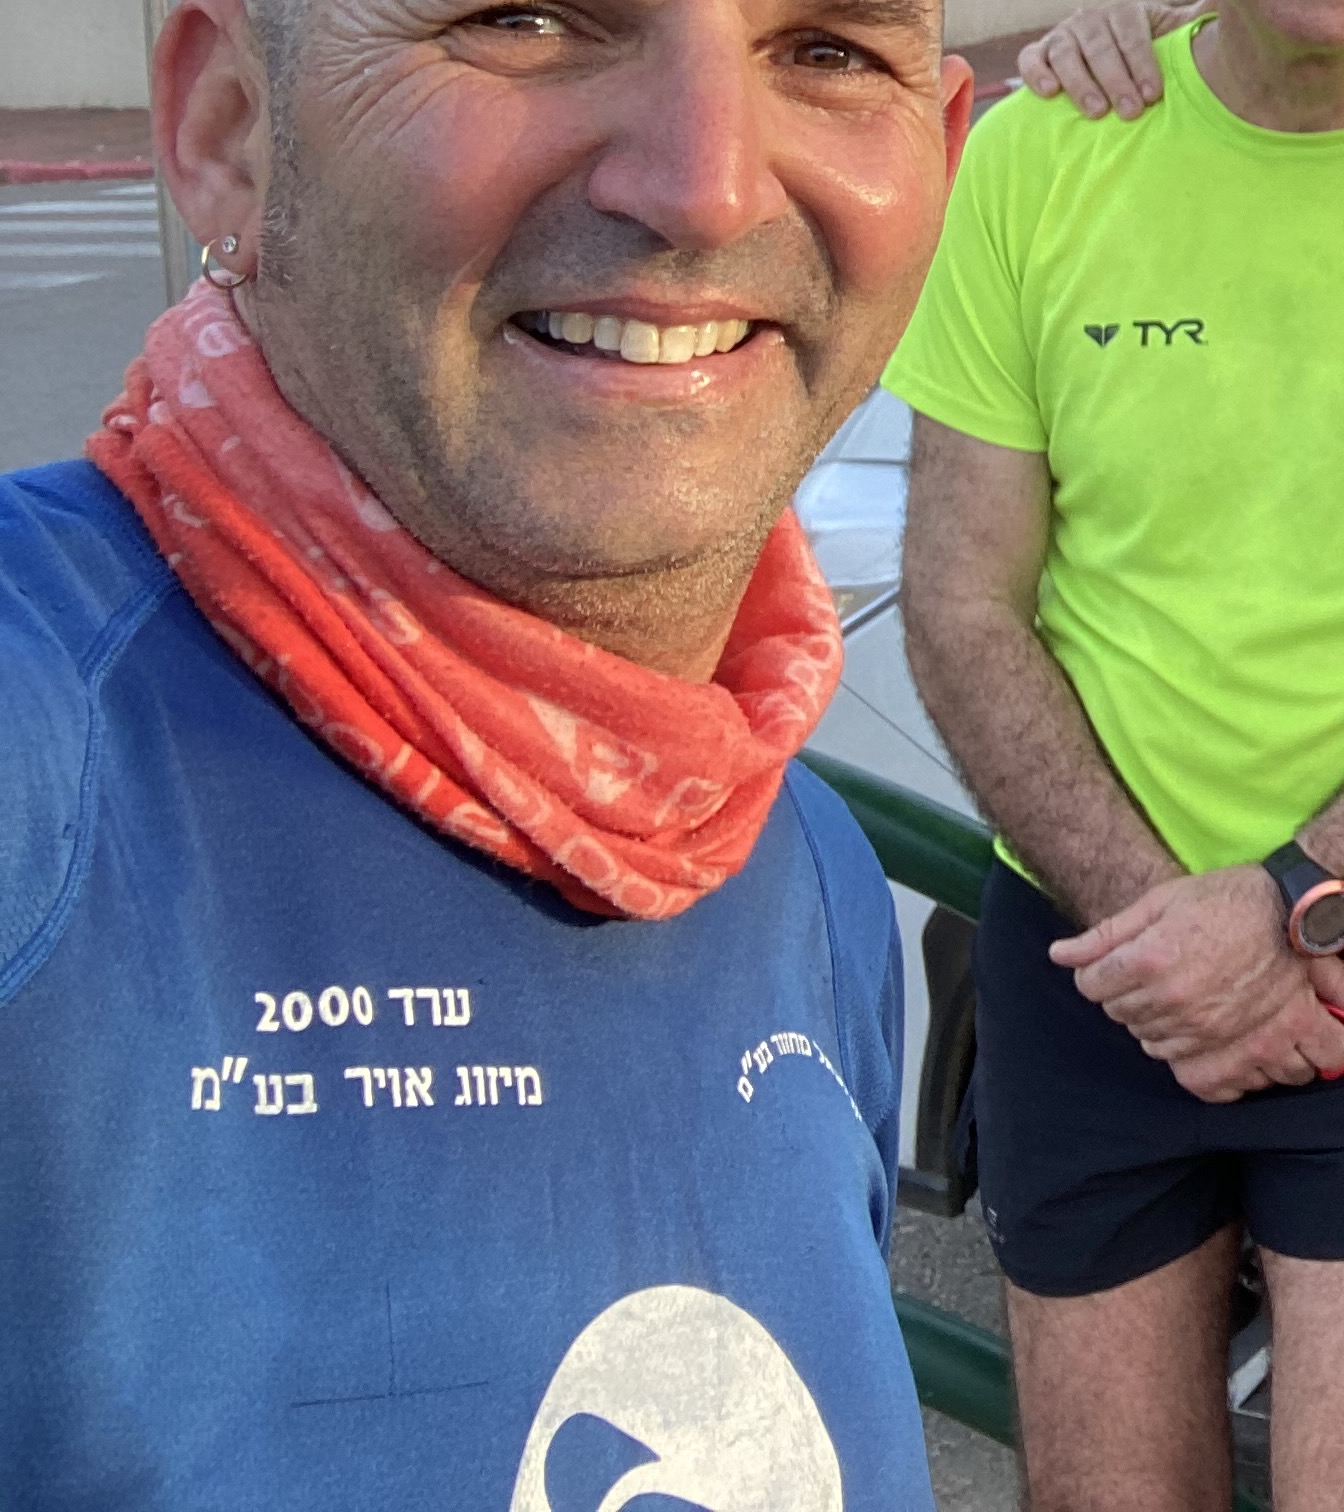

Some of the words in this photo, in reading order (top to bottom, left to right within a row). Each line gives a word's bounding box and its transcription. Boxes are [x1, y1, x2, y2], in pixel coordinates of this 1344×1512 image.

[1132, 317, 1205, 346] TYR
[254, 985, 374, 1032] 2000
[387, 987, 472, 1027] ערד
[343, 1065, 435, 1108] אויר
[454, 1065, 543, 1106] מיזוג
